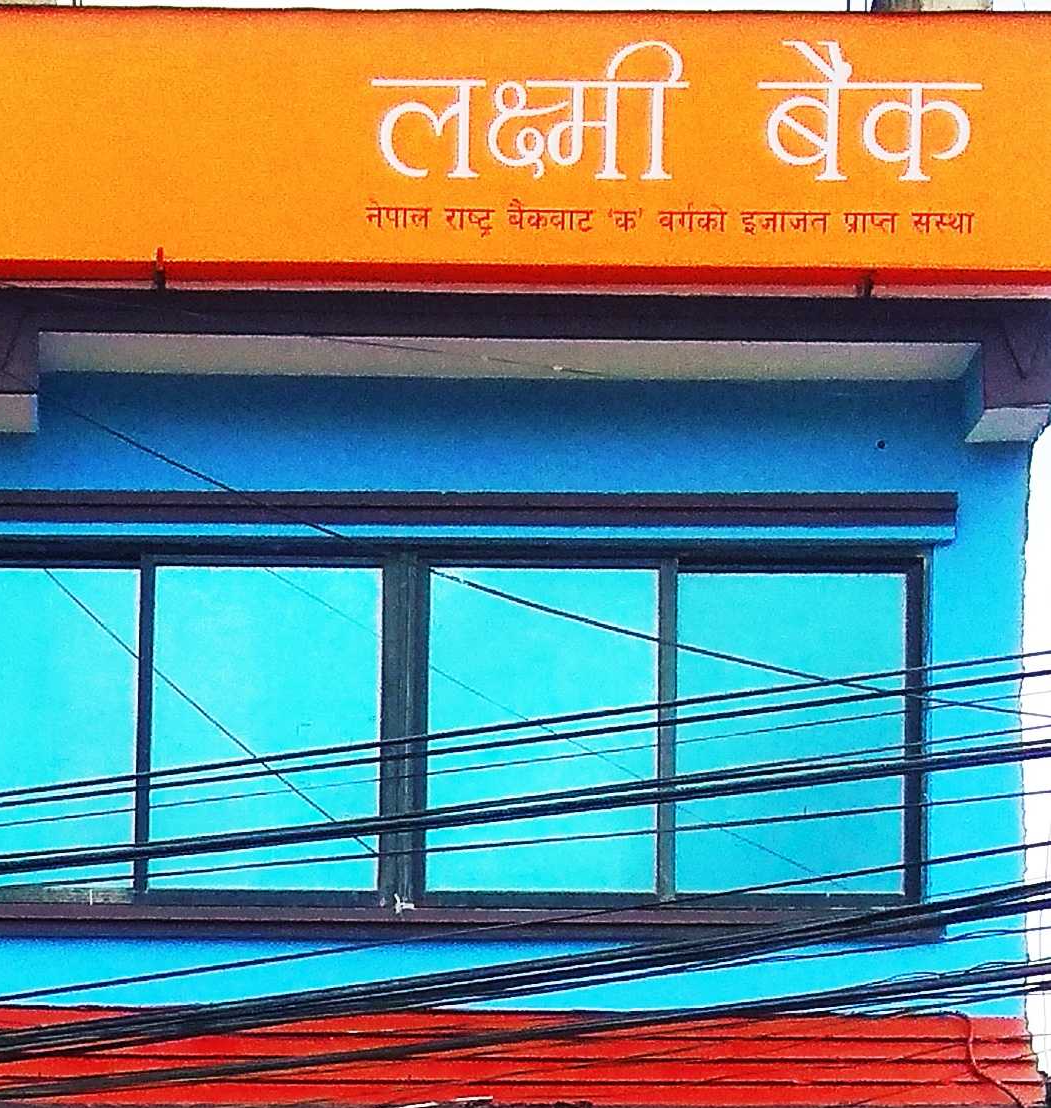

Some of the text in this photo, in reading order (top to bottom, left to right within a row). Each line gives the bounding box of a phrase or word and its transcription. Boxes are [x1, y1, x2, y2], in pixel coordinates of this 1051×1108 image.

[370, 40, 690, 182] लक्ष्मी
[365, 198, 432, 229] नेपाल
[658, 202, 728, 233] वर्गको
[740, 210, 831, 235] इजाजत
[844, 210, 900, 234] प्राप्त
